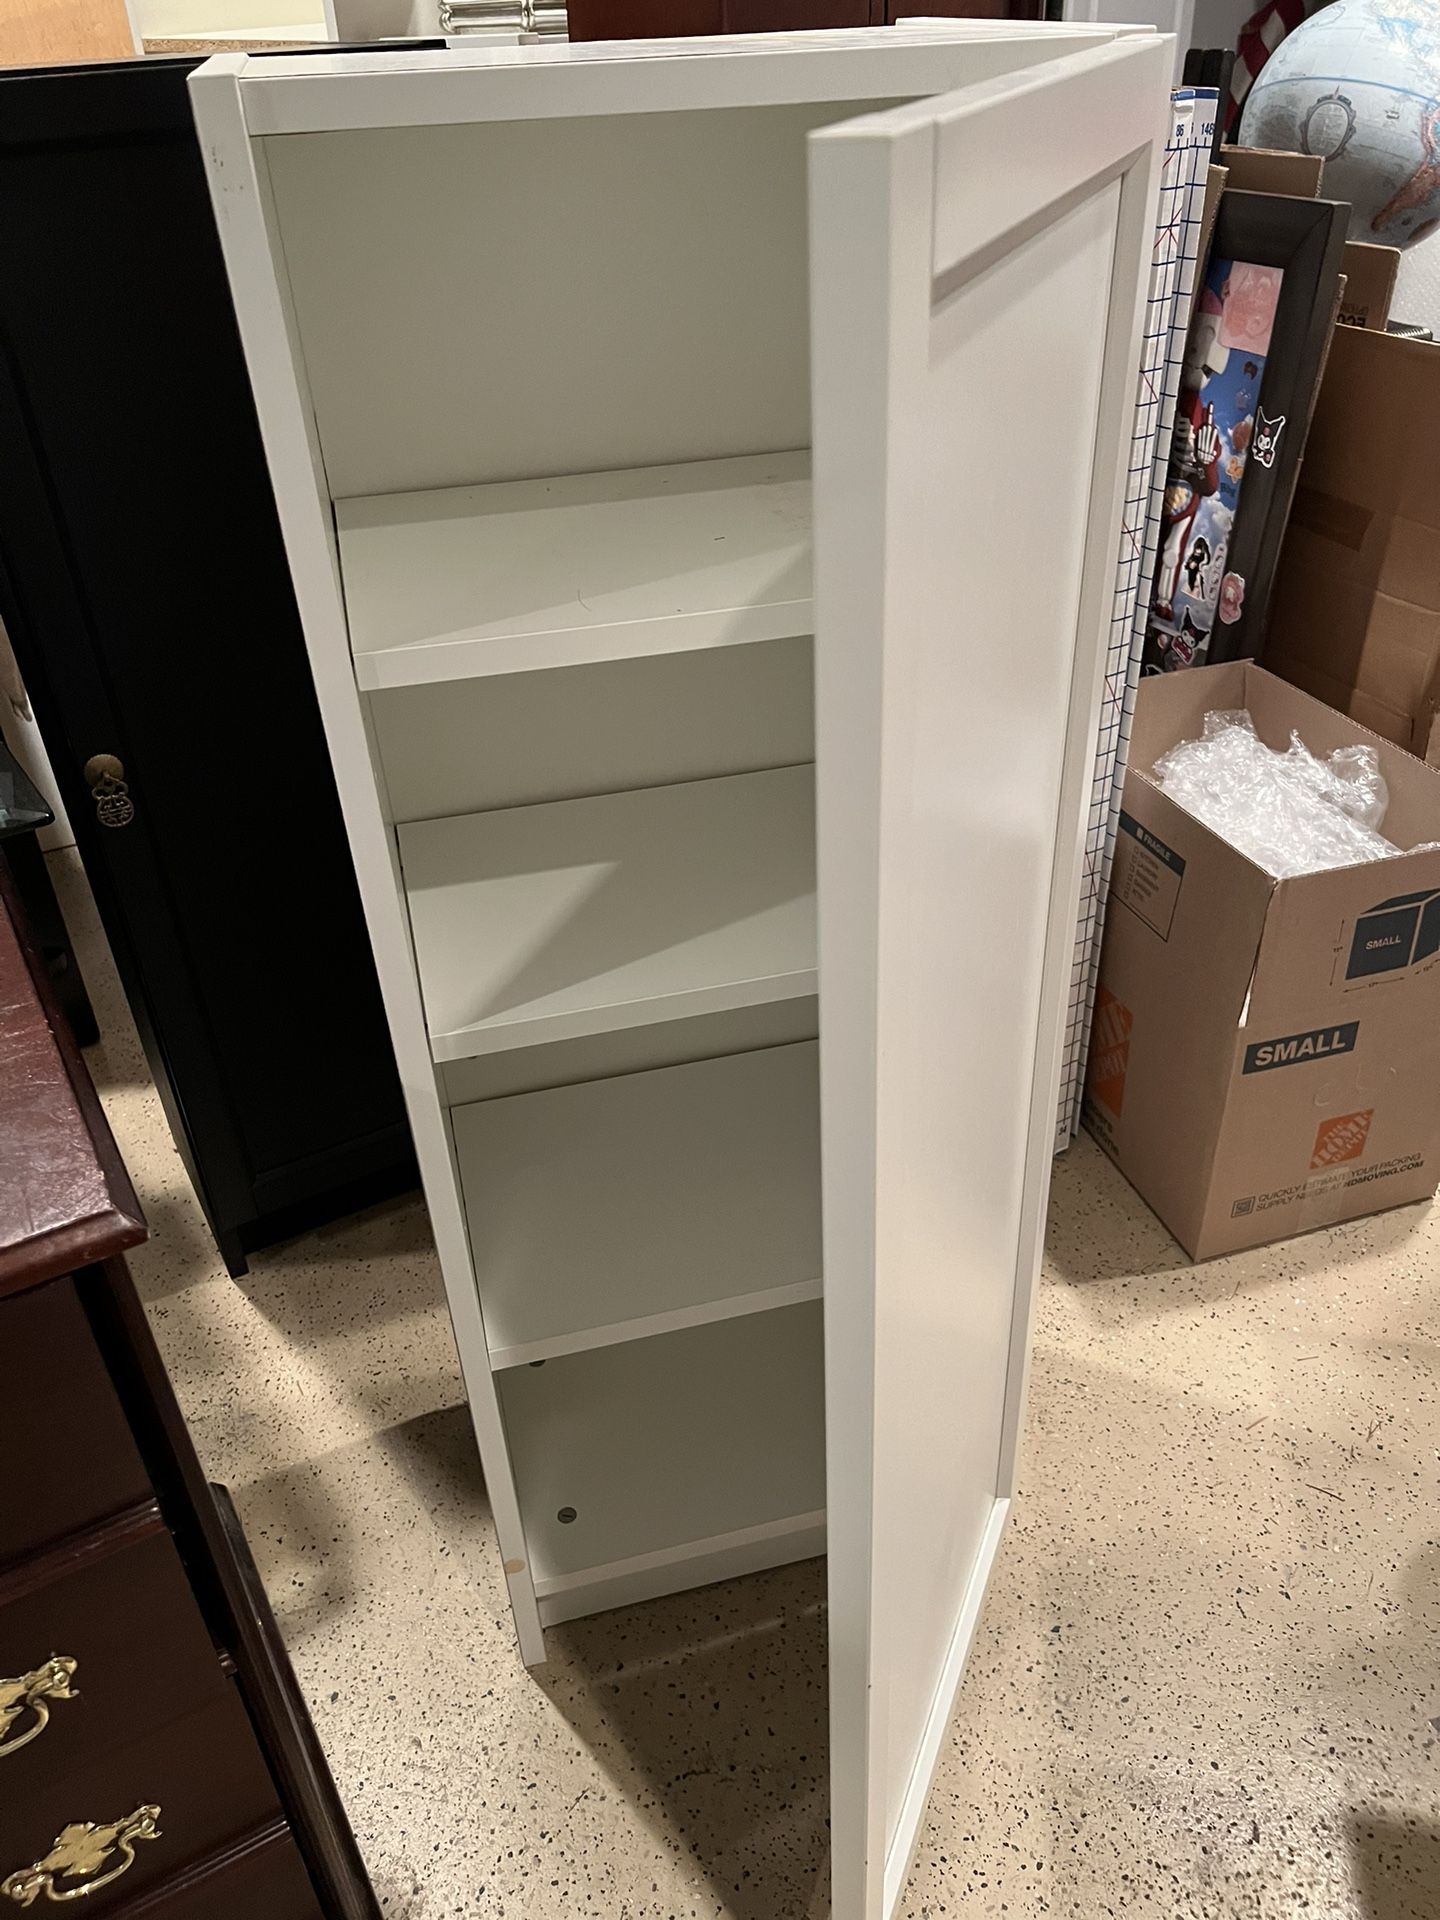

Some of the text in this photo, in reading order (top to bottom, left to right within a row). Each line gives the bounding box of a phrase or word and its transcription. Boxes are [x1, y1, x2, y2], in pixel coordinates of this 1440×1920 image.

[1143, 831, 1172, 862] FRAGILE
[1365, 934, 1401, 951] SMALL
[1254, 1031, 1346, 1067] SMALL
[1311, 1113, 1369, 1166] HOME
[1258, 1184, 1302, 1203] QUICKLY
[1350, 1162, 1379, 1177] YOUR
[1378, 1152, 1422, 1172] PACKING
[1255, 1196, 1295, 1212] SUPPLY
